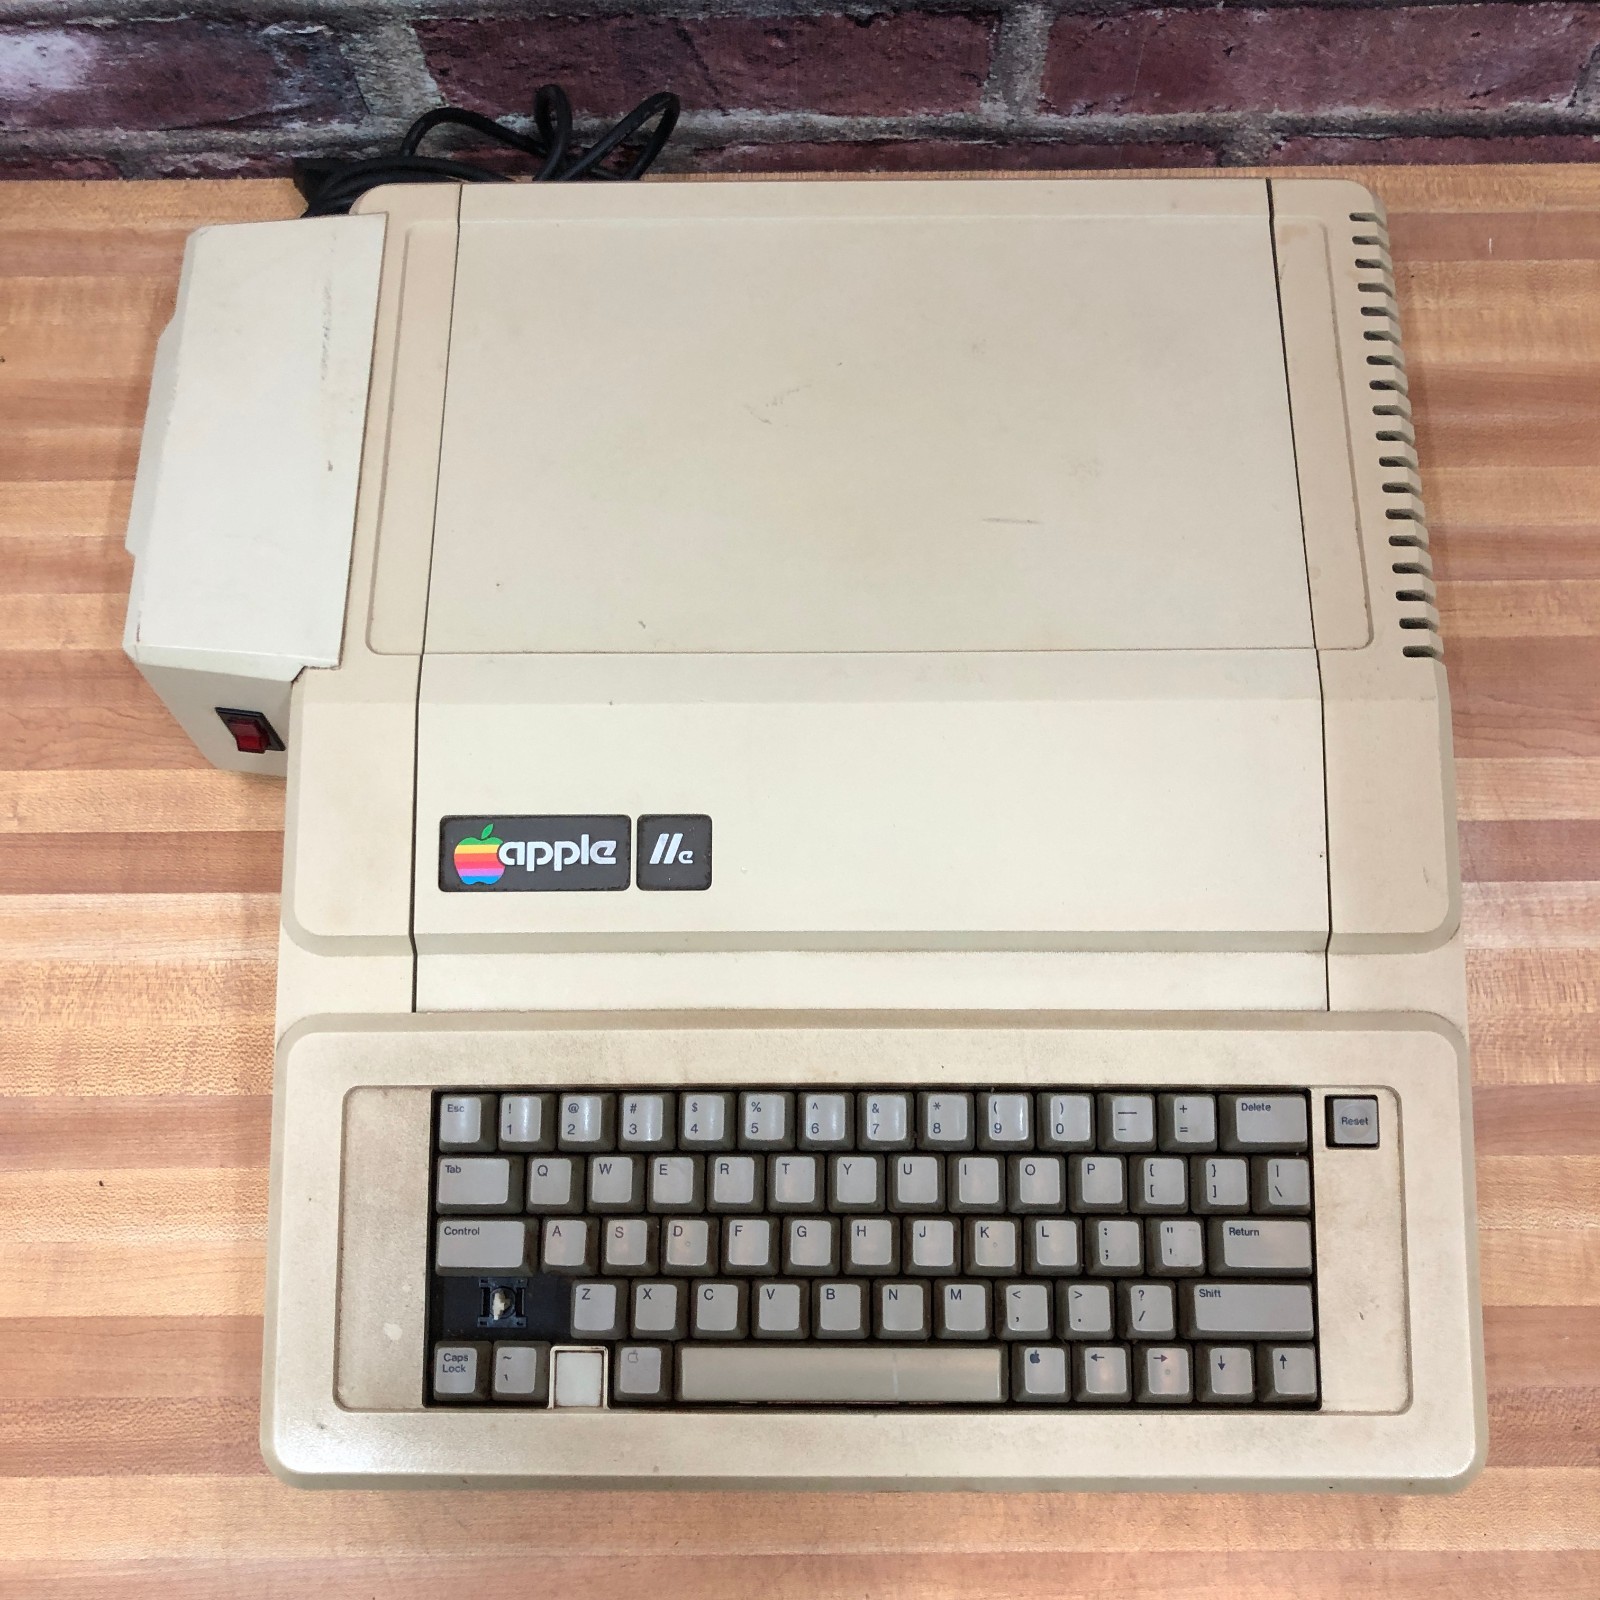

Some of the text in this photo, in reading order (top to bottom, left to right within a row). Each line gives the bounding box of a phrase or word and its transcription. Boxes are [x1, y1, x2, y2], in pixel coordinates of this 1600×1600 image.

[499, 834, 616, 871] apple
[447, 1104, 464, 1112] Esc
[508, 1104, 512, 1113] !
[568, 1103, 579, 1113] @
[630, 1104, 637, 1113] #
[691, 1102, 698, 1112] $
[751, 1102, 761, 1112] %
[872, 1103, 879, 1113] &
[1180, 1105, 1187, 1113] +
[1242, 1103, 1271, 1111] Delete
[1341, 1117, 1368, 1125] Reset
[507, 1124, 512, 1134] 1
[568, 1124, 575, 1135] 2
[629, 1123, 637, 1135] 3
[691, 1124, 698, 1133] 4
[751, 1123, 758, 1133] 5
[812, 1123, 819, 1134] 6
[873, 1124, 879, 1134] 7
[933, 1123, 941, 1134] 8
[994, 1123, 1002, 1133] 9
[1056, 1123, 1064, 1134] 0
[445, 1165, 461, 1173] Tab
[537, 1165, 548, 1176] Q
[599, 1164, 612, 1174] W
[660, 1164, 667, 1175] E
[720, 1163, 729, 1174] R
[782, 1163, 790, 1174] T
[843, 1164, 852, 1175] Y
[904, 1164, 912, 1175] U
[963, 1164, 967, 1175] I
[1025, 1164, 1035, 1176] O
[1087, 1164, 1095, 1174] P
[444, 1226, 479, 1235] Control
[552, 1226, 561, 1236] A
[615, 1226, 623, 1238] S
[673, 1226, 683, 1236] D
[735, 1225, 742, 1236] F
[797, 1226, 806, 1237] G
[857, 1226, 866, 1236] H
[919, 1226, 926, 1237] J
[981, 1227, 989, 1238] K
[1042, 1226, 1049, 1237] L
[1229, 1227, 1259, 1236] Return
[582, 1288, 590, 1300] Z
[643, 1288, 651, 1299] X
[704, 1289, 713, 1300] C
[767, 1289, 775, 1299] V
[826, 1288, 835, 1299] B
[889, 1289, 897, 1300] N
[951, 1289, 961, 1300] M
[1074, 1291, 1082, 1299] >
[1138, 1290, 1145, 1300] ?
[1199, 1289, 1221, 1297] Shift
[443, 1353, 468, 1363] Caps
[443, 1363, 465, 1373] Lock
